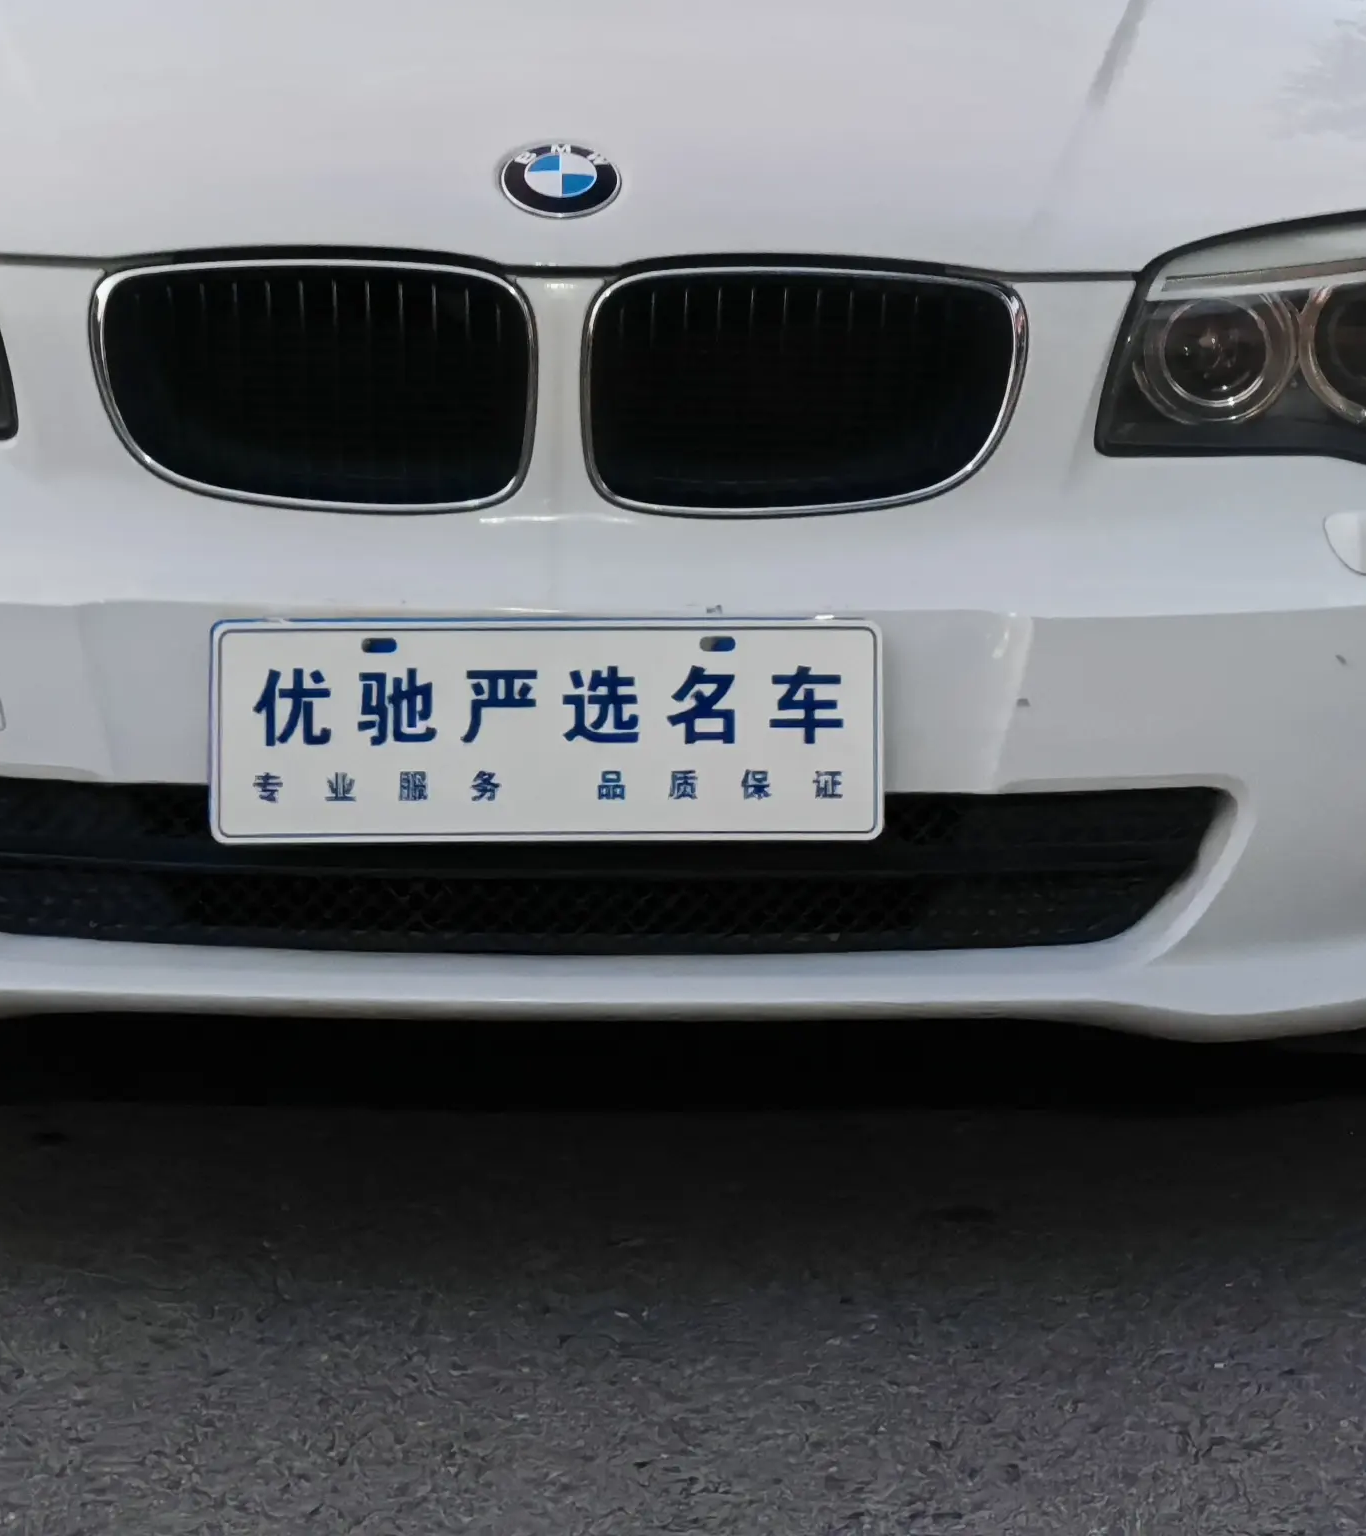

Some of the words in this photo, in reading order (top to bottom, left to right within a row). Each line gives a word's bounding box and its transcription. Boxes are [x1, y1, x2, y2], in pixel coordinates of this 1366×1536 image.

[514, 143, 610, 165] BMW
[253, 666, 844, 746] 优驰严选名车
[253, 770, 501, 803] 专业服务
[597, 770, 844, 803] 品质保证
